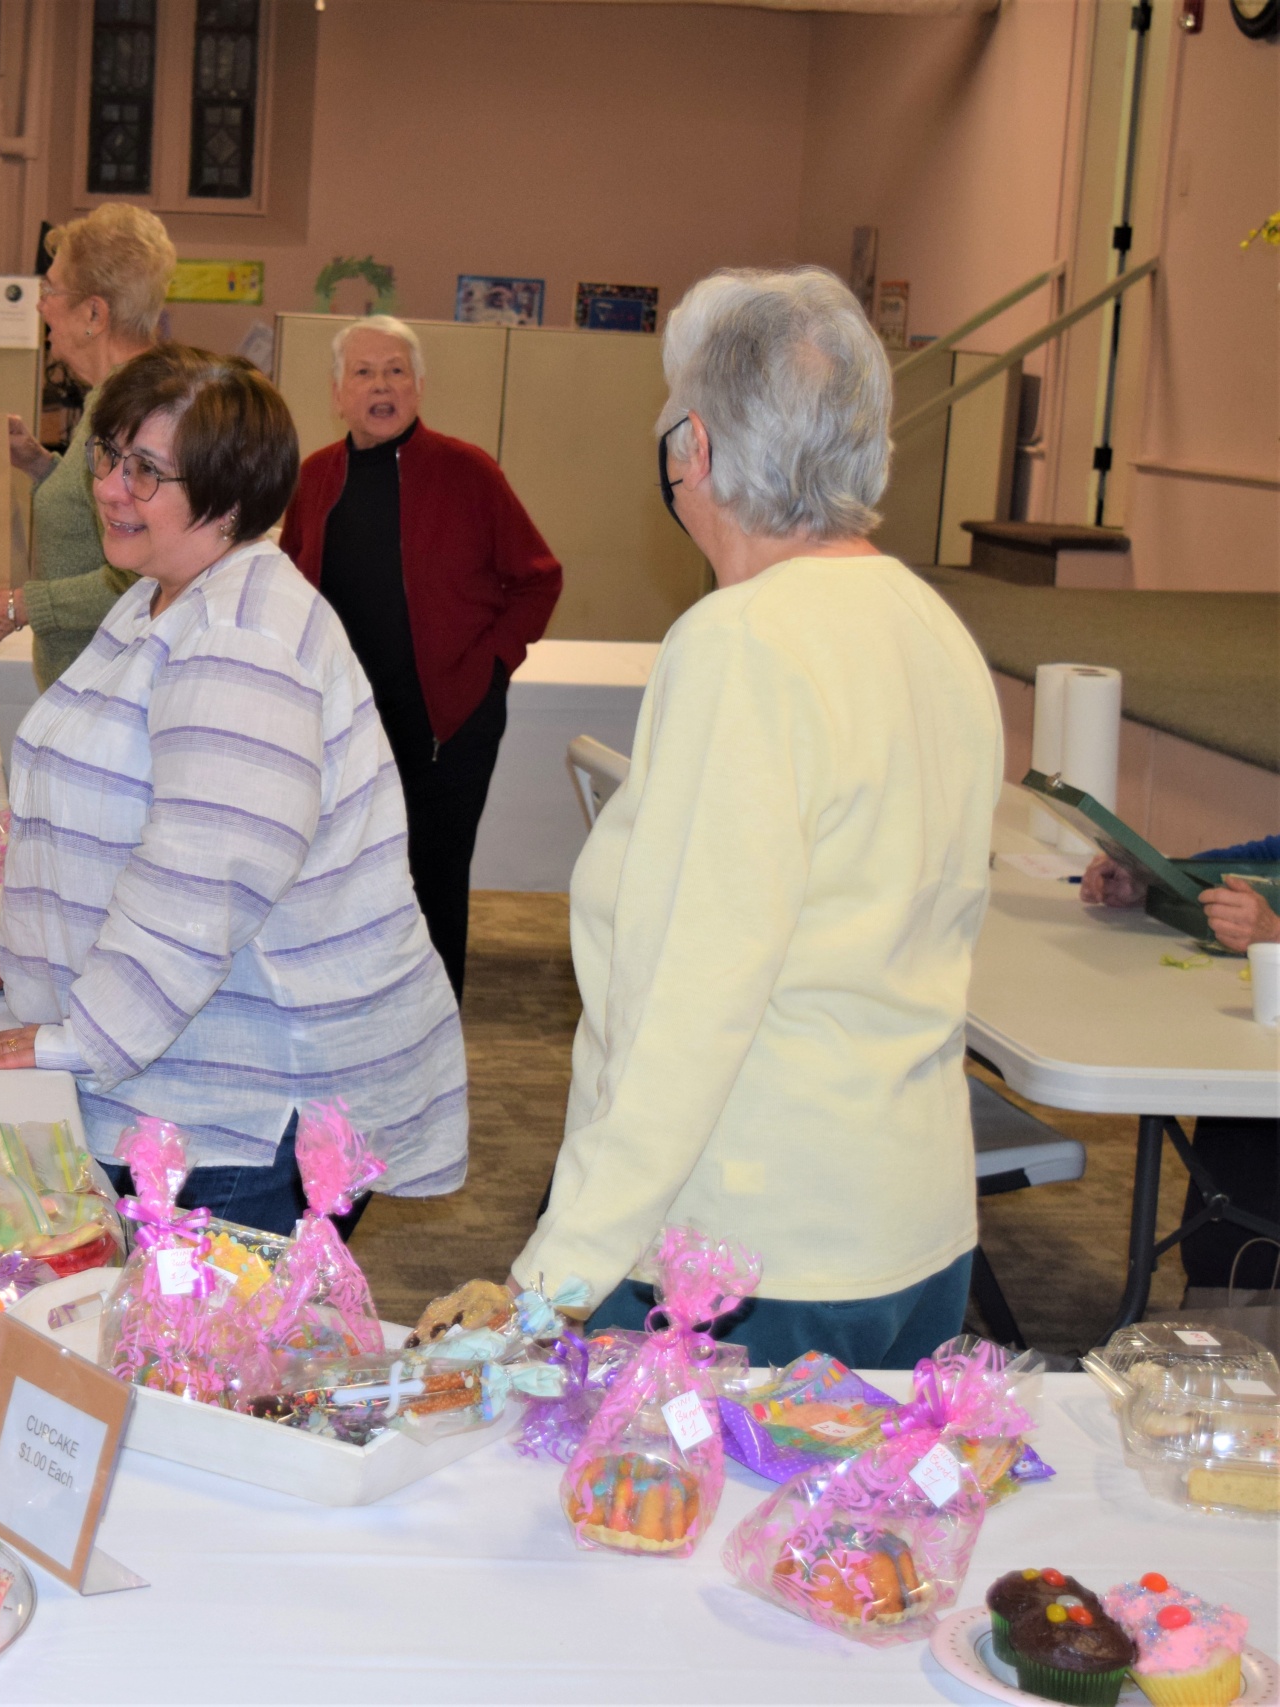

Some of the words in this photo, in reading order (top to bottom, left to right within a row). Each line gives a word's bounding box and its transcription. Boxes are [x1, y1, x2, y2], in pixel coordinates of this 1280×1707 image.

[26, 1414, 80, 1459] CUPCAKE
[18, 1442, 48, 1471] $1.00
[47, 1459, 74, 1489] Each
